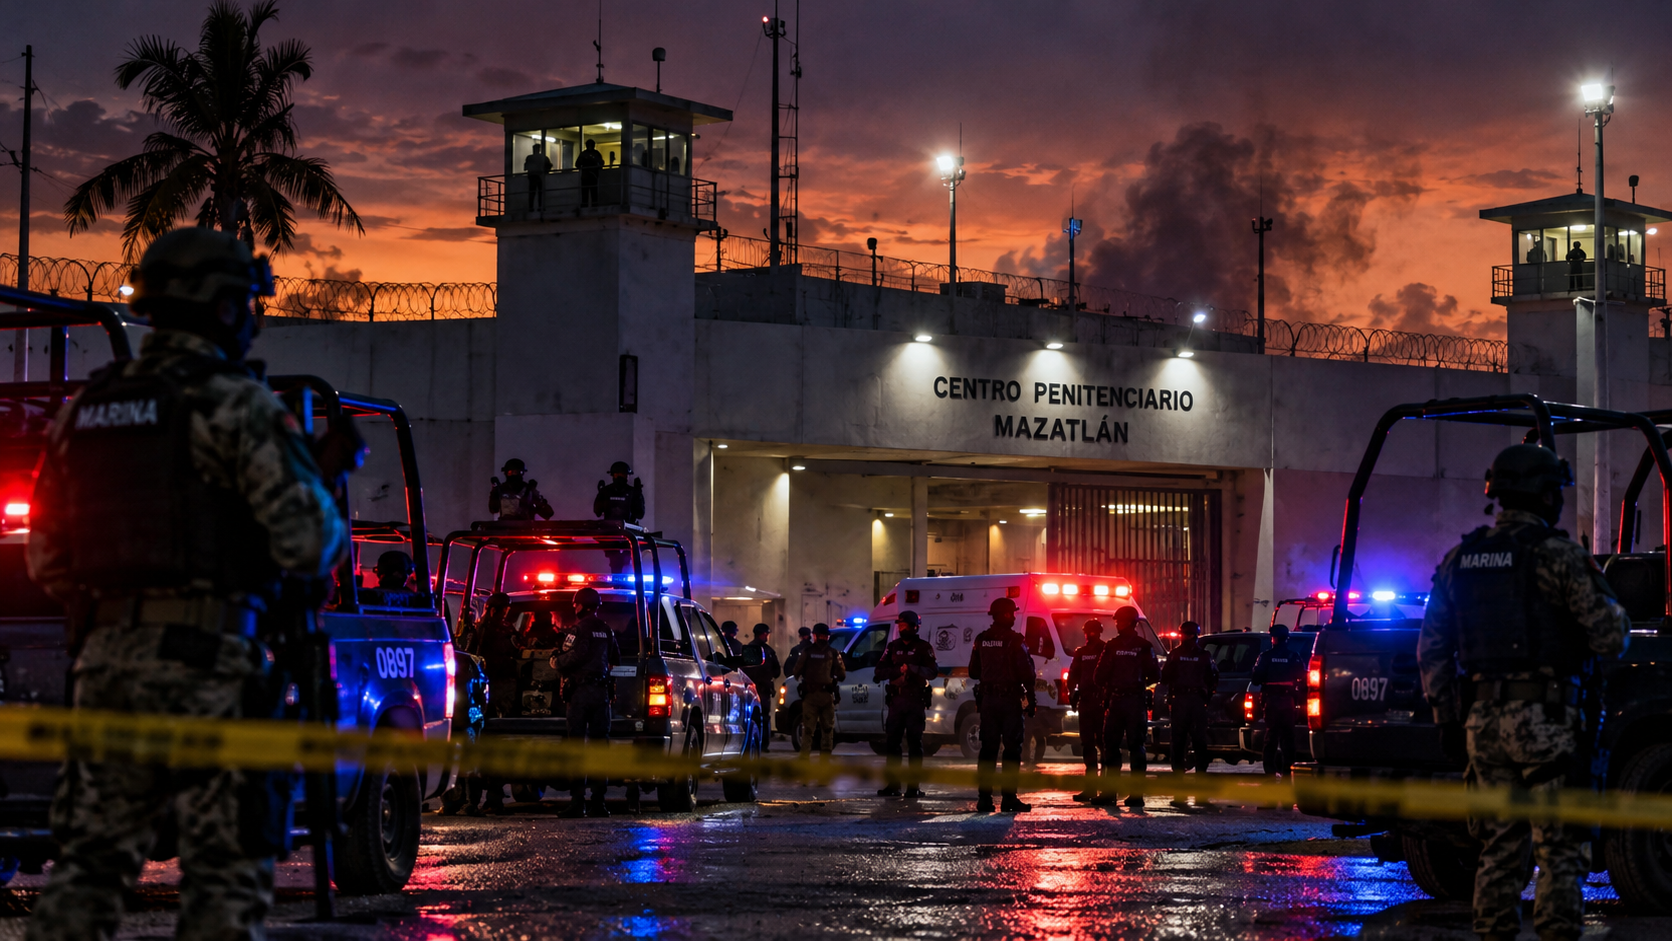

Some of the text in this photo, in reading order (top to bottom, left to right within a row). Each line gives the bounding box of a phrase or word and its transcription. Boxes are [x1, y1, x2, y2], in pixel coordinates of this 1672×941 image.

[933, 376, 1194, 412] CENTRO PENITENCIARIO
[995, 414, 1129, 443] MAZATLÁN
[1459, 551, 1513, 569] MARINA
[375, 646, 415, 679] 0897
[1351, 676, 1389, 701] 0897
